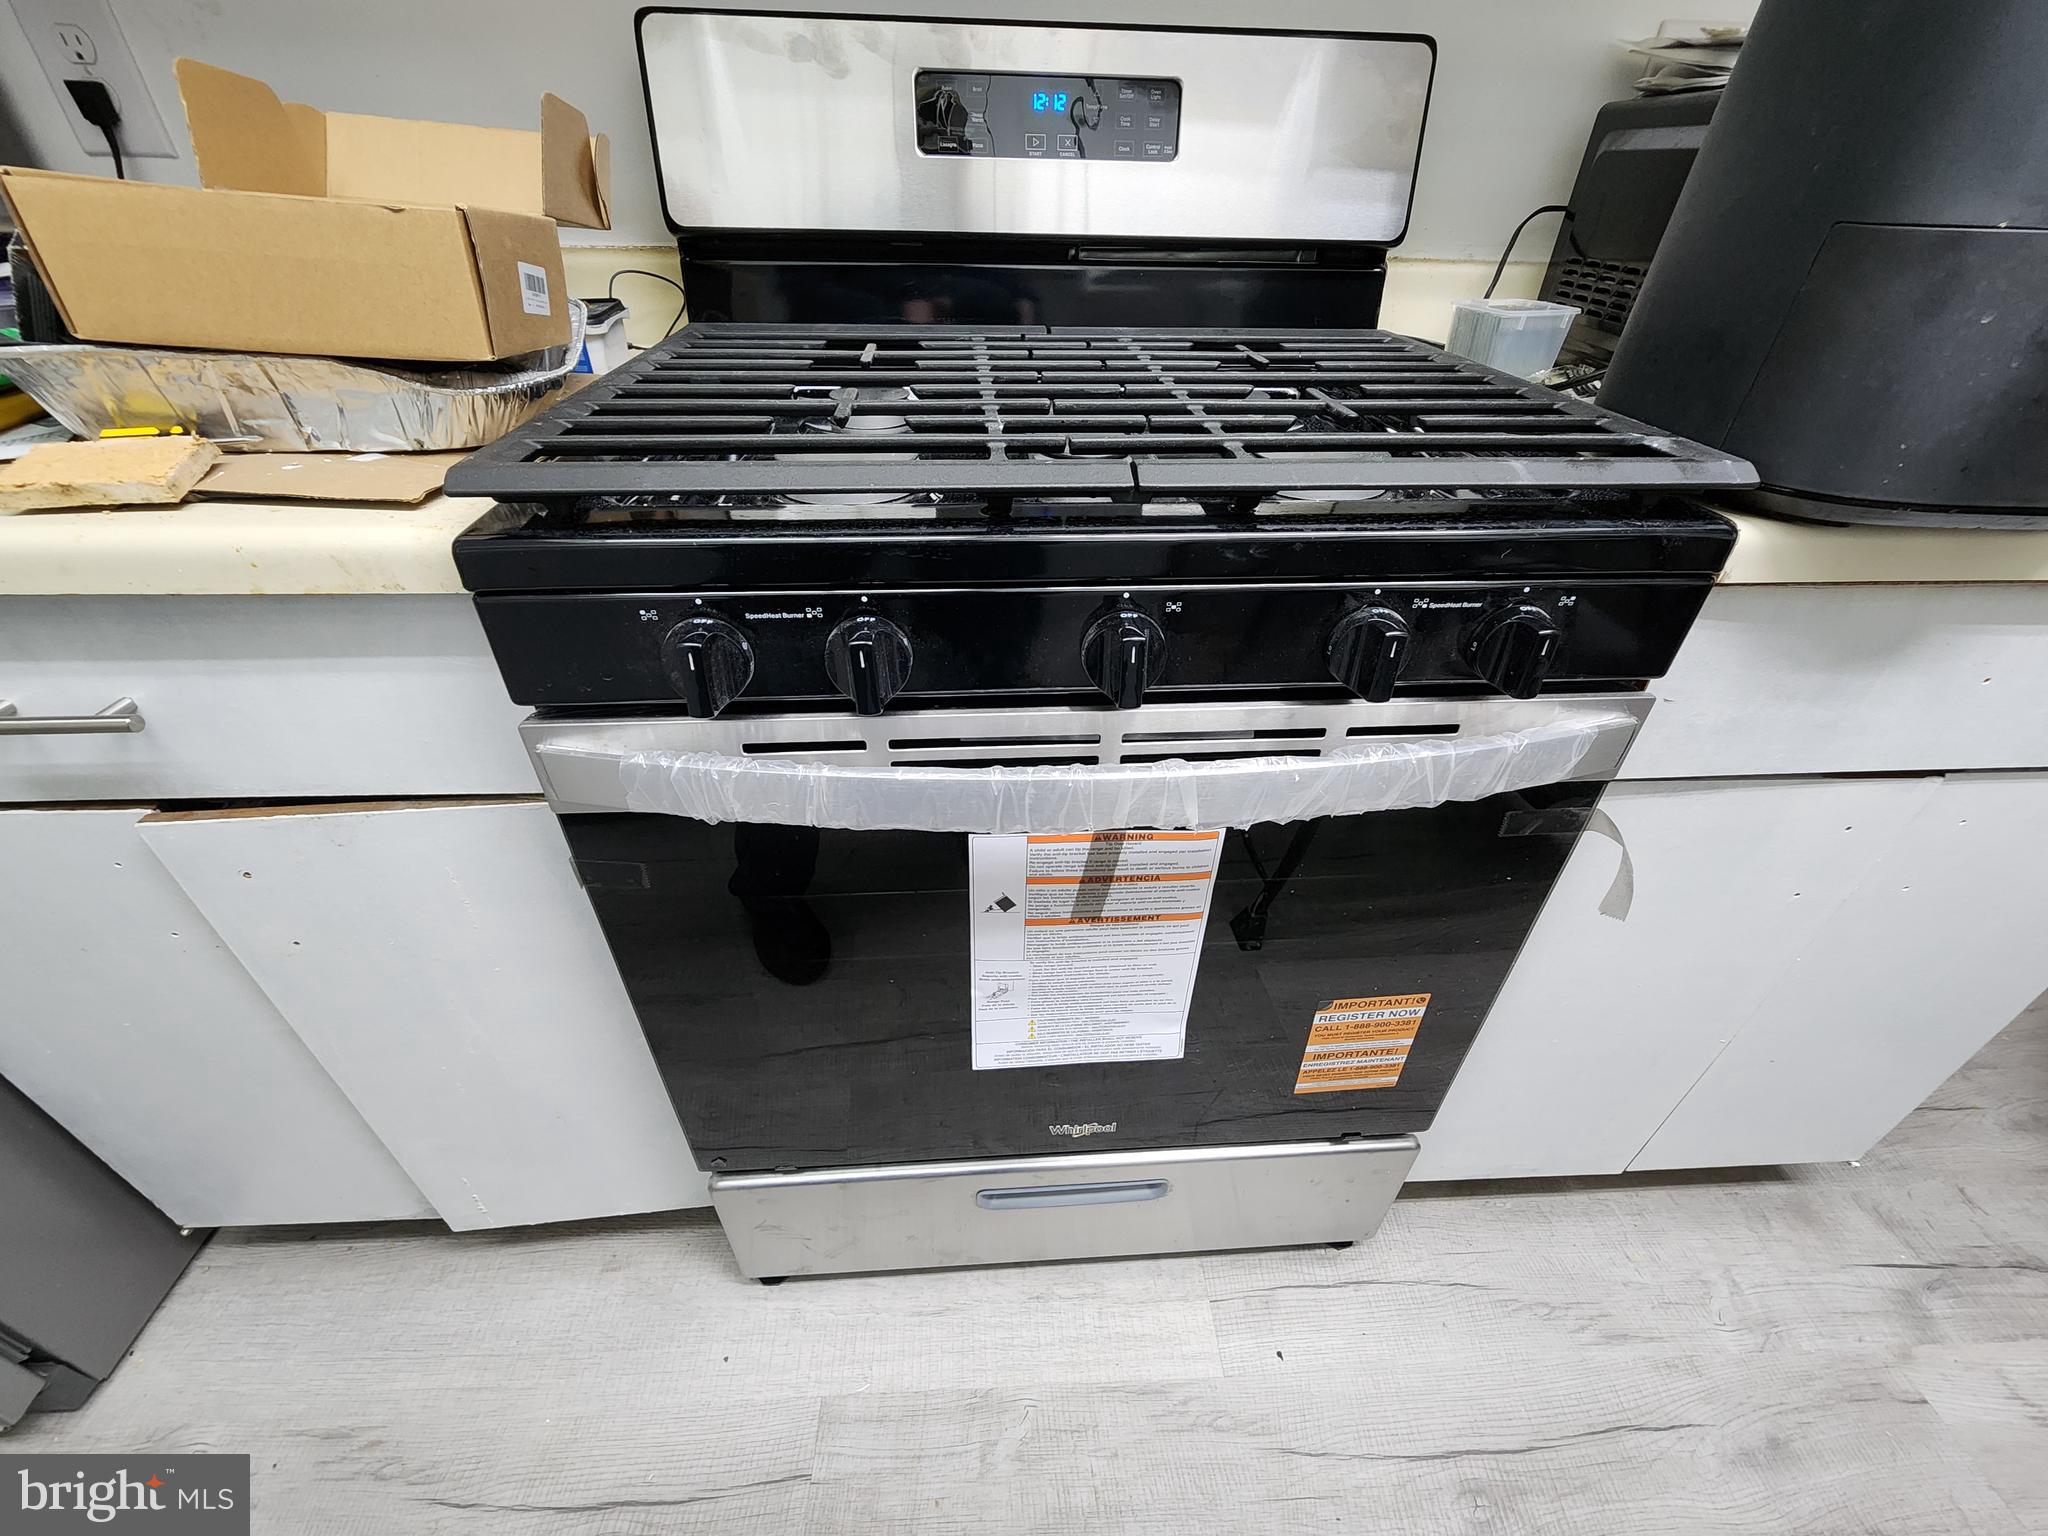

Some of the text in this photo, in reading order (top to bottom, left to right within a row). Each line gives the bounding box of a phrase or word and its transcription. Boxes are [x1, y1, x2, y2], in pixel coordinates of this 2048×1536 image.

[1033, 93, 1067, 111] 12:12
[1104, 832, 1154, 841] WARNING
[1086, 875, 1161, 883] ADVERTENCIA
[1077, 914, 1161, 924] AVERTISSEMENT
[1334, 998, 1416, 1010] IMPORTANT!
[1318, 1009, 1421, 1022] REGISTER NOW
[1344, 1020, 1417, 1030] 1-888-900-3381
[1312, 1048, 1399, 1060] IMPORTANTE!
[1303, 1056, 1405, 1068] ENREGISTREZ MAINTENANT
[1049, 1122, 1117, 1138] Whirlpool
